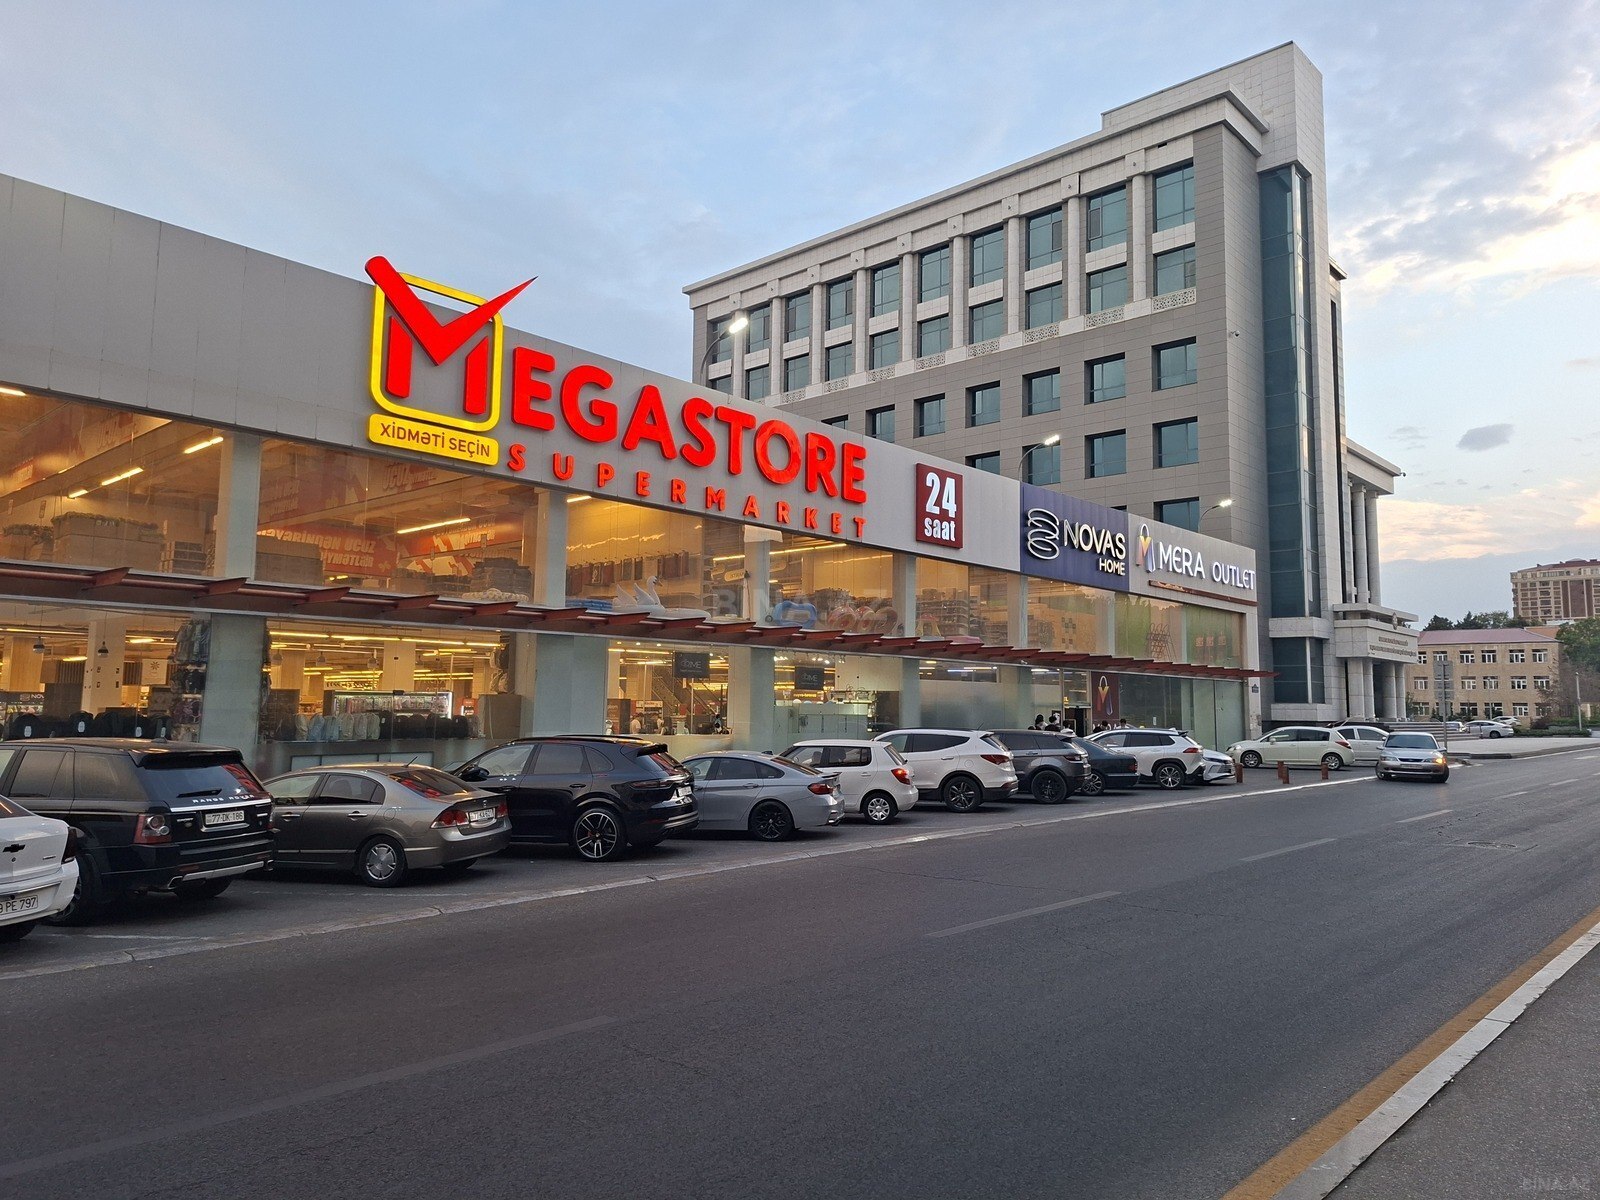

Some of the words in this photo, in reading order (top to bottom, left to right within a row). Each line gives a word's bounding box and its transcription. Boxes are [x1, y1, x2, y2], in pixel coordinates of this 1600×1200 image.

[365, 256, 867, 504] MEGASTORE
[380, 421, 445, 448] XİDMƏTİ
[448, 437, 490, 458] SEÇİN
[506, 443, 867, 538] SUPERMARKET
[925, 472, 957, 518] 24
[924, 517, 956, 542] saat
[1063, 519, 1126, 560] NOVAS
[1099, 557, 1126, 576] HOME
[1159, 541, 1206, 579] MERA
[1211, 562, 1256, 590] OUTLET
[6, 901, 17, 912] PE
[20, 897, 36, 909] 797
